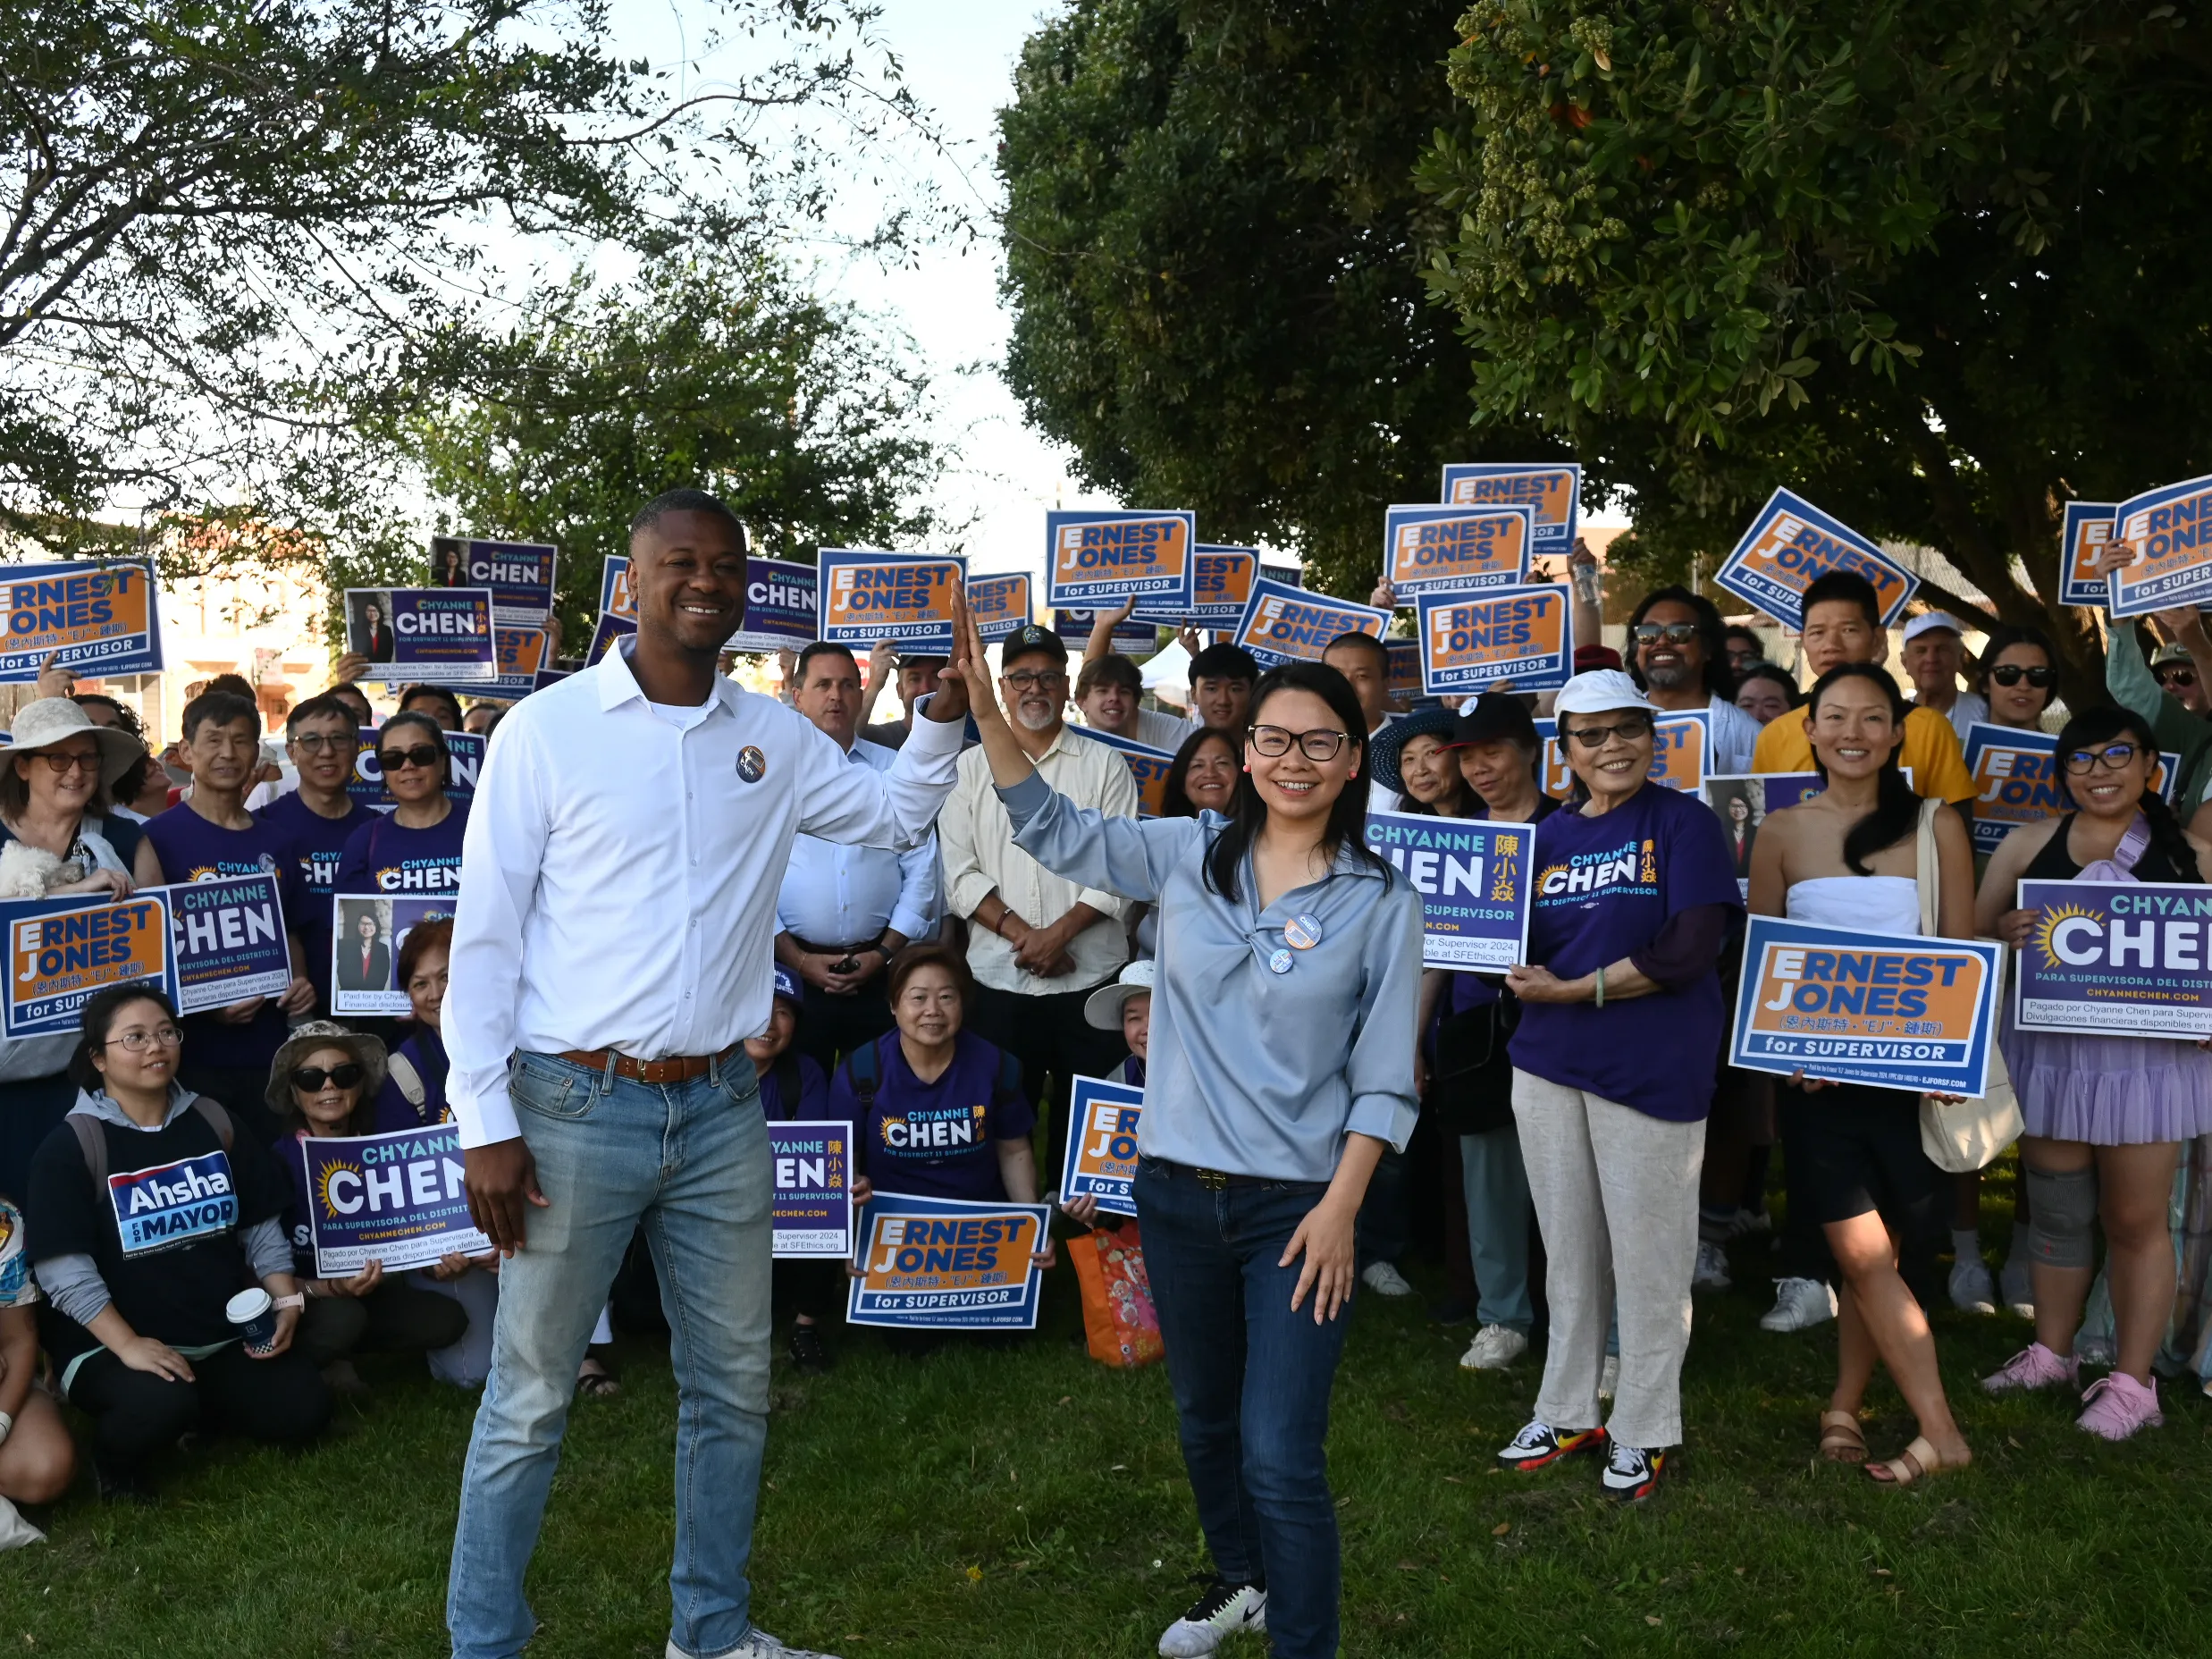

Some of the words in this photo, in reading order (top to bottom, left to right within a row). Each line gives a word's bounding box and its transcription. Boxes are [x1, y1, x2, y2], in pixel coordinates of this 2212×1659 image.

[1459, 475, 1564, 500] ERNEST
[2128, 494, 2212, 541] ERNE
[1064, 522, 1177, 548] ERNEST
[1403, 518, 1515, 547] ERNEST
[2131, 519, 2212, 566] JONE
[492, 552, 539, 563] CHYANNE
[1061, 544, 1157, 570] JONES
[1400, 540, 1493, 568] JONES
[1757, 539, 1829, 580] JON
[1772, 517, 1899, 591] ERNEST
[471, 561, 538, 583] CHEN
[770, 573, 816, 587] CHYANNE
[836, 566, 952, 591] ERNEST
[1742, 572, 1765, 590] for
[2134, 585, 2159, 598] for
[2162, 567, 2211, 590] SUPER
[0, 570, 134, 611] ERNEST
[968, 579, 1021, 600] NEST
[1064, 585, 1084, 596] for
[1088, 580, 1171, 594] SUPERVISOR
[1401, 582, 1420, 594] for
[1425, 575, 1506, 591] SUPERVISOR
[2083, 584, 2107, 593] for
[419, 600, 472, 610] CHYANNE
[747, 582, 817, 611] CHEN
[833, 588, 930, 612] JONES
[396, 612, 476, 634] CHEN
[1262, 598, 1374, 632] ERNEST
[1434, 596, 1552, 633] ERNEST
[837, 627, 856, 638] for
[859, 625, 941, 638] SUPERVISOR
[1435, 622, 1532, 654] JONES
[0, 657, 23, 669] for
[1249, 649, 1268, 661] for
[1440, 669, 1459, 682] for
[1462, 659, 1547, 679] SUPERVISOR
[1367, 823, 1485, 853] CHYANNE
[1973, 823, 2001, 836] for
[217, 861, 261, 873] CHYAN
[401, 857, 461, 870] CHYANNE
[1542, 854, 1636, 894] CHEN
[184, 884, 268, 910] CHYANNE
[1535, 899, 1549, 907] FOR
[1552, 894, 1590, 906] DISTRICT
[1601, 887, 1658, 896] SUPERVISOR
[2110, 895, 2212, 917] CHYAN
[1425, 905, 1515, 921] SUPERVISOR
[20, 904, 152, 953] ERNEST
[1438, 939, 1487, 949] Supervisor
[1490, 941, 1517, 951] 2024.
[2052, 916, 2212, 971] CHE
[19, 936, 131, 981] JONES
[179, 959, 220, 971] PERVISORA
[222, 956, 235, 964] DEL
[237, 950, 270, 961] DISTRITO
[1453, 950, 1514, 964] SFEthics.org
[1771, 949, 1969, 987] ERNEST
[181, 964, 250, 981] CHYANNECHEN.COM
[2035, 973, 2066, 981] PARA
[2070, 974, 2152, 986] SUPERVISORA
[2157, 979, 2178, 988] DEL
[2182, 980, 2212, 989] DIST
[181, 986, 206, 998] Chyanne
[207, 983, 223, 992] Chen
[223, 981, 236, 990] para
[237, 975, 271, 988] Supervisora
[187, 993, 217, 1003] financieras
[217, 988, 248, 999] disponibles
[374, 992, 382, 1001] by
[383, 992, 409, 1001] Chyan
[2086, 989, 2199, 1001] CHYANNECHEN.COM
[1764, 981, 1930, 1018] JONES
[26, 1004, 50, 1018] for
[2025, 1012, 2087, 1023] Divulgaciones
[2090, 1015, 2138, 1026] financieras
[2140, 1017, 2192, 1030] disponibles
[2030, 1001, 2064, 1012] Pagado
[2066, 1005, 2081, 1015] por
[2083, 1005, 2124, 1015] Chyanne
[2125, 1006, 2150, 1015] Chen
[2152, 1010, 2174, 1020] para
[2176, 1009, 2212, 1021] Supervi
[1765, 1037, 1797, 1054] for
[1804, 1039, 1946, 1060] SUPERVISOR
[1922, 1076, 1966, 1088] EJFORSF.COM
[907, 1107, 969, 1122] CHYANNE
[886, 1119, 971, 1148] CHEN
[362, 1133, 461, 1165] CHYANN
[770, 1141, 824, 1154] YANNE
[883, 1147, 896, 1156] FOR
[898, 1150, 933, 1158] DISTRICT
[776, 1158, 825, 1189] EN
[130, 1166, 231, 1215] Ahsha
[789, 1192, 843, 1200] SUPERVISOR
[1089, 1178, 1114, 1193] for
[141, 1200, 234, 1241] MAYOR
[323, 1223, 342, 1231] PARA
[345, 1217, 407, 1230] SUPERVISORA
[409, 1213, 427, 1222] DEL
[430, 1204, 469, 1218] DISTRIT
[131, 1222, 141, 1243] FOR
[358, 1221, 446, 1241] CHYANNECHEN.COM
[777, 1233, 817, 1242] Supervisor
[879, 1218, 1027, 1245] ERNEST
[324, 1249, 346, 1259] Pagado
[347, 1250, 357, 1259] por
[358, 1246, 388, 1257] Chyanne
[390, 1243, 408, 1252] Chen
[410, 1242, 428, 1252] para
[429, 1232, 474, 1248] Supervisora
[790, 1242, 838, 1251] SFEthics.org
[323, 1259, 363, 1268] Divulgaciones
[402, 1247, 444, 1261] disponibles
[873, 1246, 998, 1274] JONES
[874, 1295, 900, 1309] for
[905, 1290, 1009, 1309] SUPERVISOR
